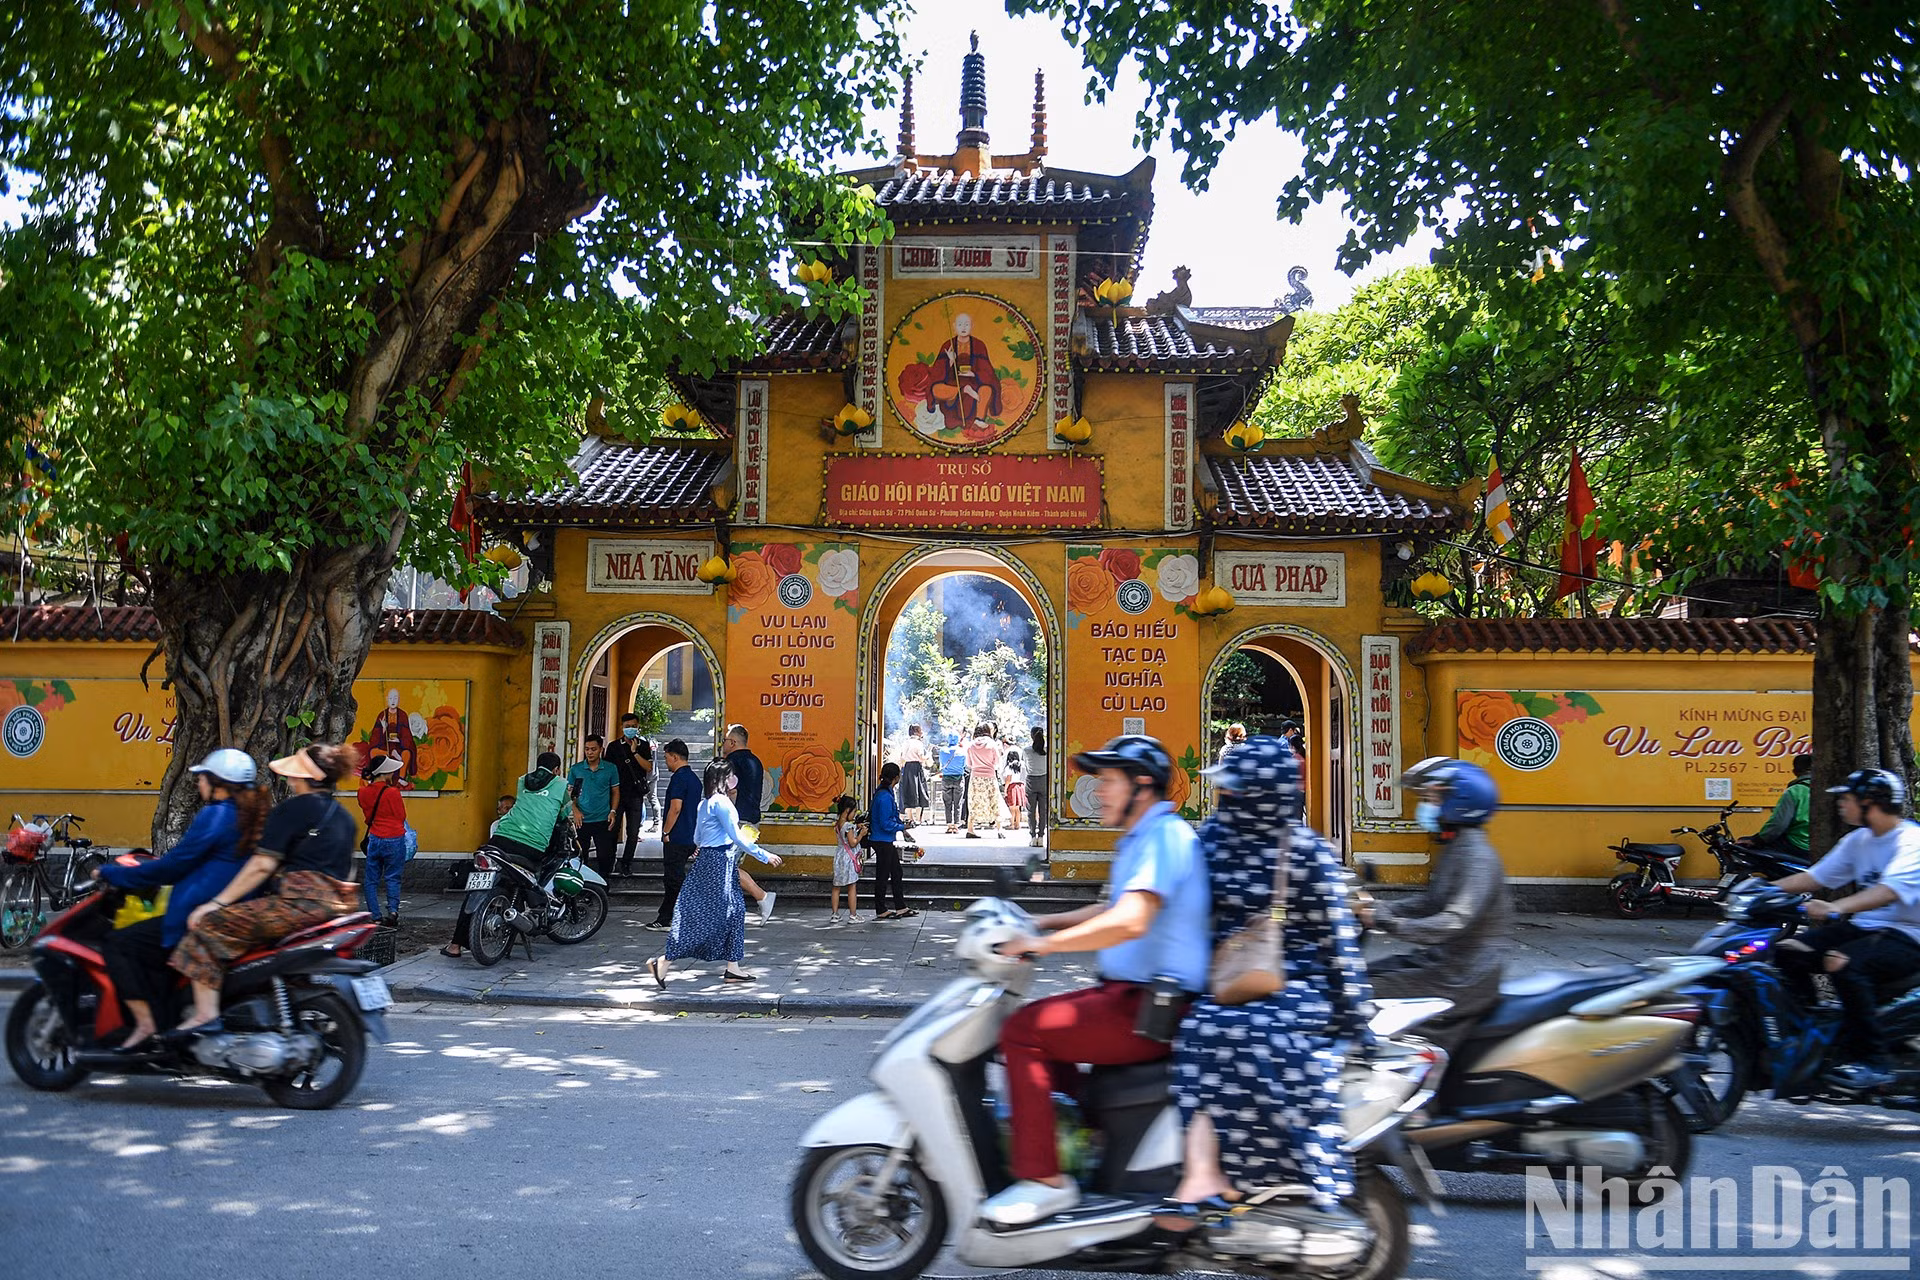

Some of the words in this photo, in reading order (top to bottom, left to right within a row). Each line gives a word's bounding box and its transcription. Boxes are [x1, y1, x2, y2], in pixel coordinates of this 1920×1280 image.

[937, 463, 968, 478] TRỤ
[971, 460, 992, 475] SỞ
[841, 480, 880, 502] GIÁO
[884, 481, 912, 505] HỘI
[916, 481, 959, 505] PHẬT
[962, 481, 1001, 503] GIÁO
[1007, 482, 1042, 506] VIỆT
[1046, 485, 1086, 503] NAM
[651, 550, 699, 581] TĂNG
[1275, 564, 1328, 593] PHÁP
[761, 615, 787, 630] VU
[791, 615, 828, 630] LAN
[1091, 620, 1130, 639] BÁO
[1134, 618, 1178, 639] HIẾU
[751, 634, 783, 649] GHI
[787, 631, 836, 649] LÒNG
[780, 654, 807, 669] ƠN
[1101, 647, 1137, 667] TẠC
[1141, 647, 1168, 667] DẠ
[770, 673, 815, 688] SINH
[1105, 668, 1165, 688] NGHĨA
[760, 690, 825, 708] DƯỠNG
[1101, 692, 1126, 712] CÙ
[1130, 696, 1168, 712] LAO
[1679, 707, 1718, 722] KÍNH
[1723, 708, 1774, 722] MỪNG
[1778, 710, 1807, 725] ĐẠI
[113, 712, 152, 744] Vu
[1603, 725, 1662, 758] Vu
[1668, 725, 1744, 758] Lan
[1685, 762, 1747, 773] PL.2567
